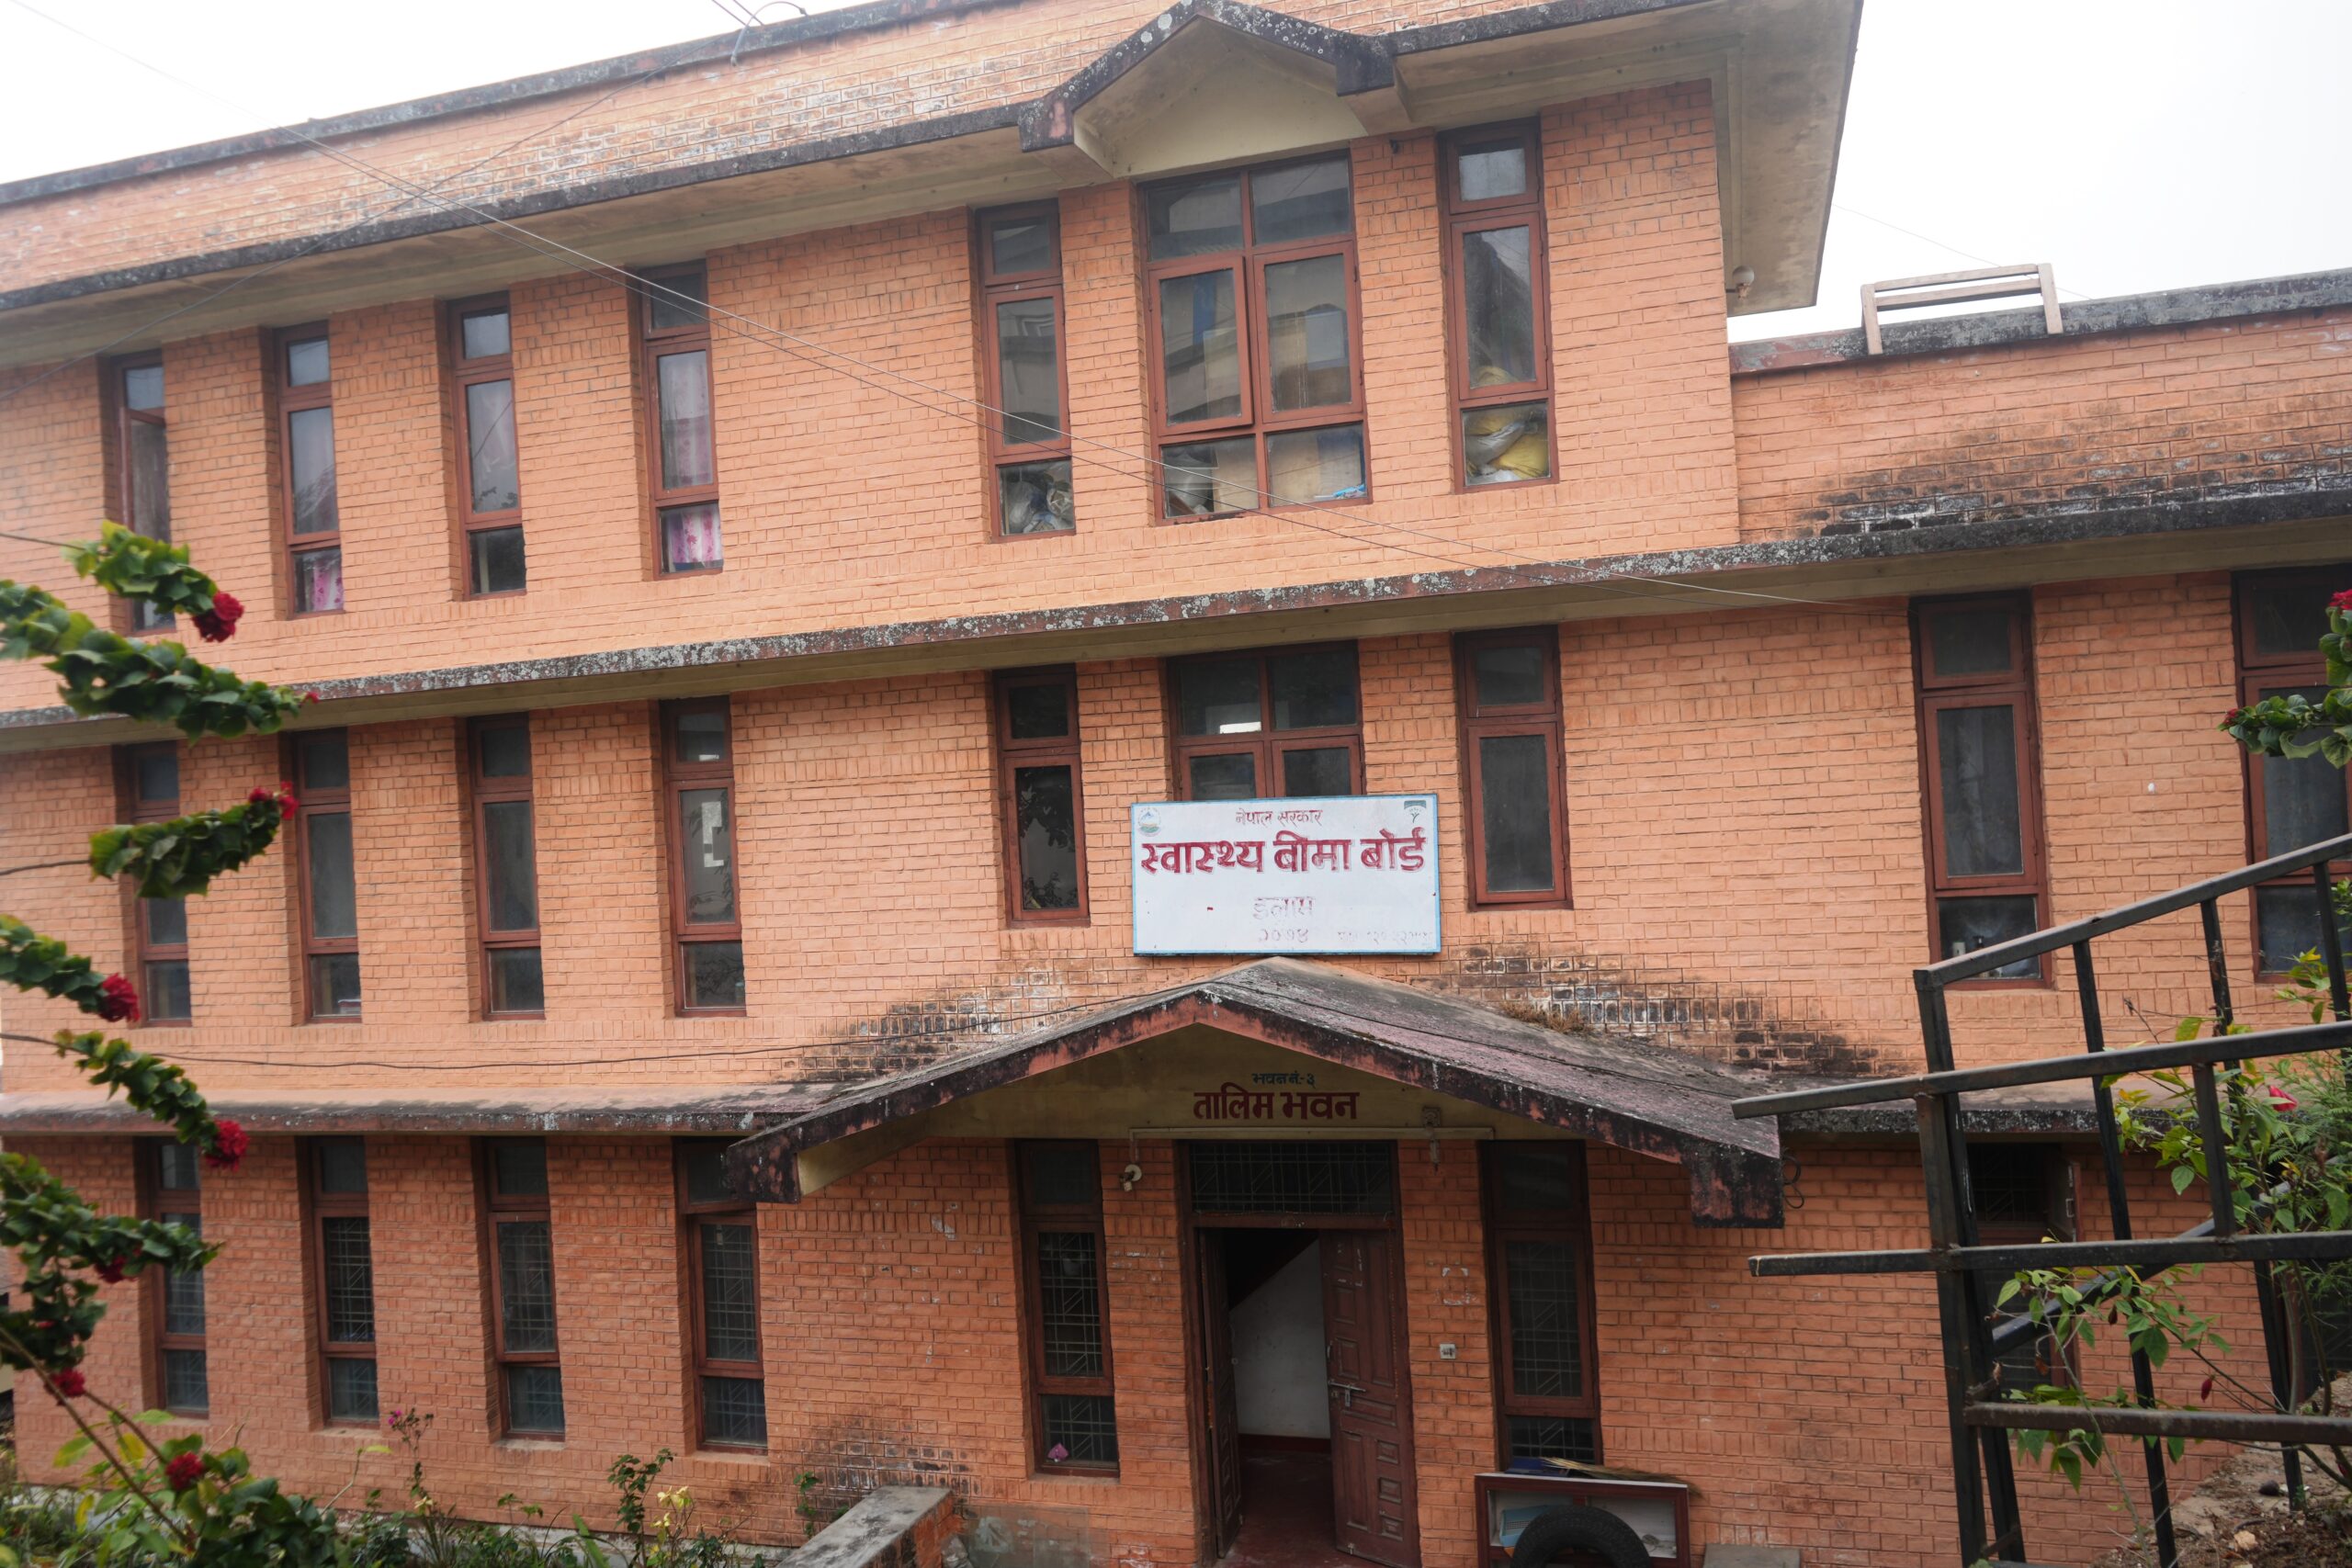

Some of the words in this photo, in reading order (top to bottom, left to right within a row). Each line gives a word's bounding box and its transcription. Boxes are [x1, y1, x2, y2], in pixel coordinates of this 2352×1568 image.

[1236, 807, 1273, 828] नेपाल
[1277, 809, 1324, 827] सरकार
[1140, 840, 1266, 874] स्वास्थ्य
[1272, 829, 1351, 872] बीमा
[1360, 827, 1426, 872] बोर्ड
[1251, 1071, 1287, 1085] भवन
[1193, 1081, 1275, 1120] तालिम
[1280, 1091, 1361, 1120] भवन
